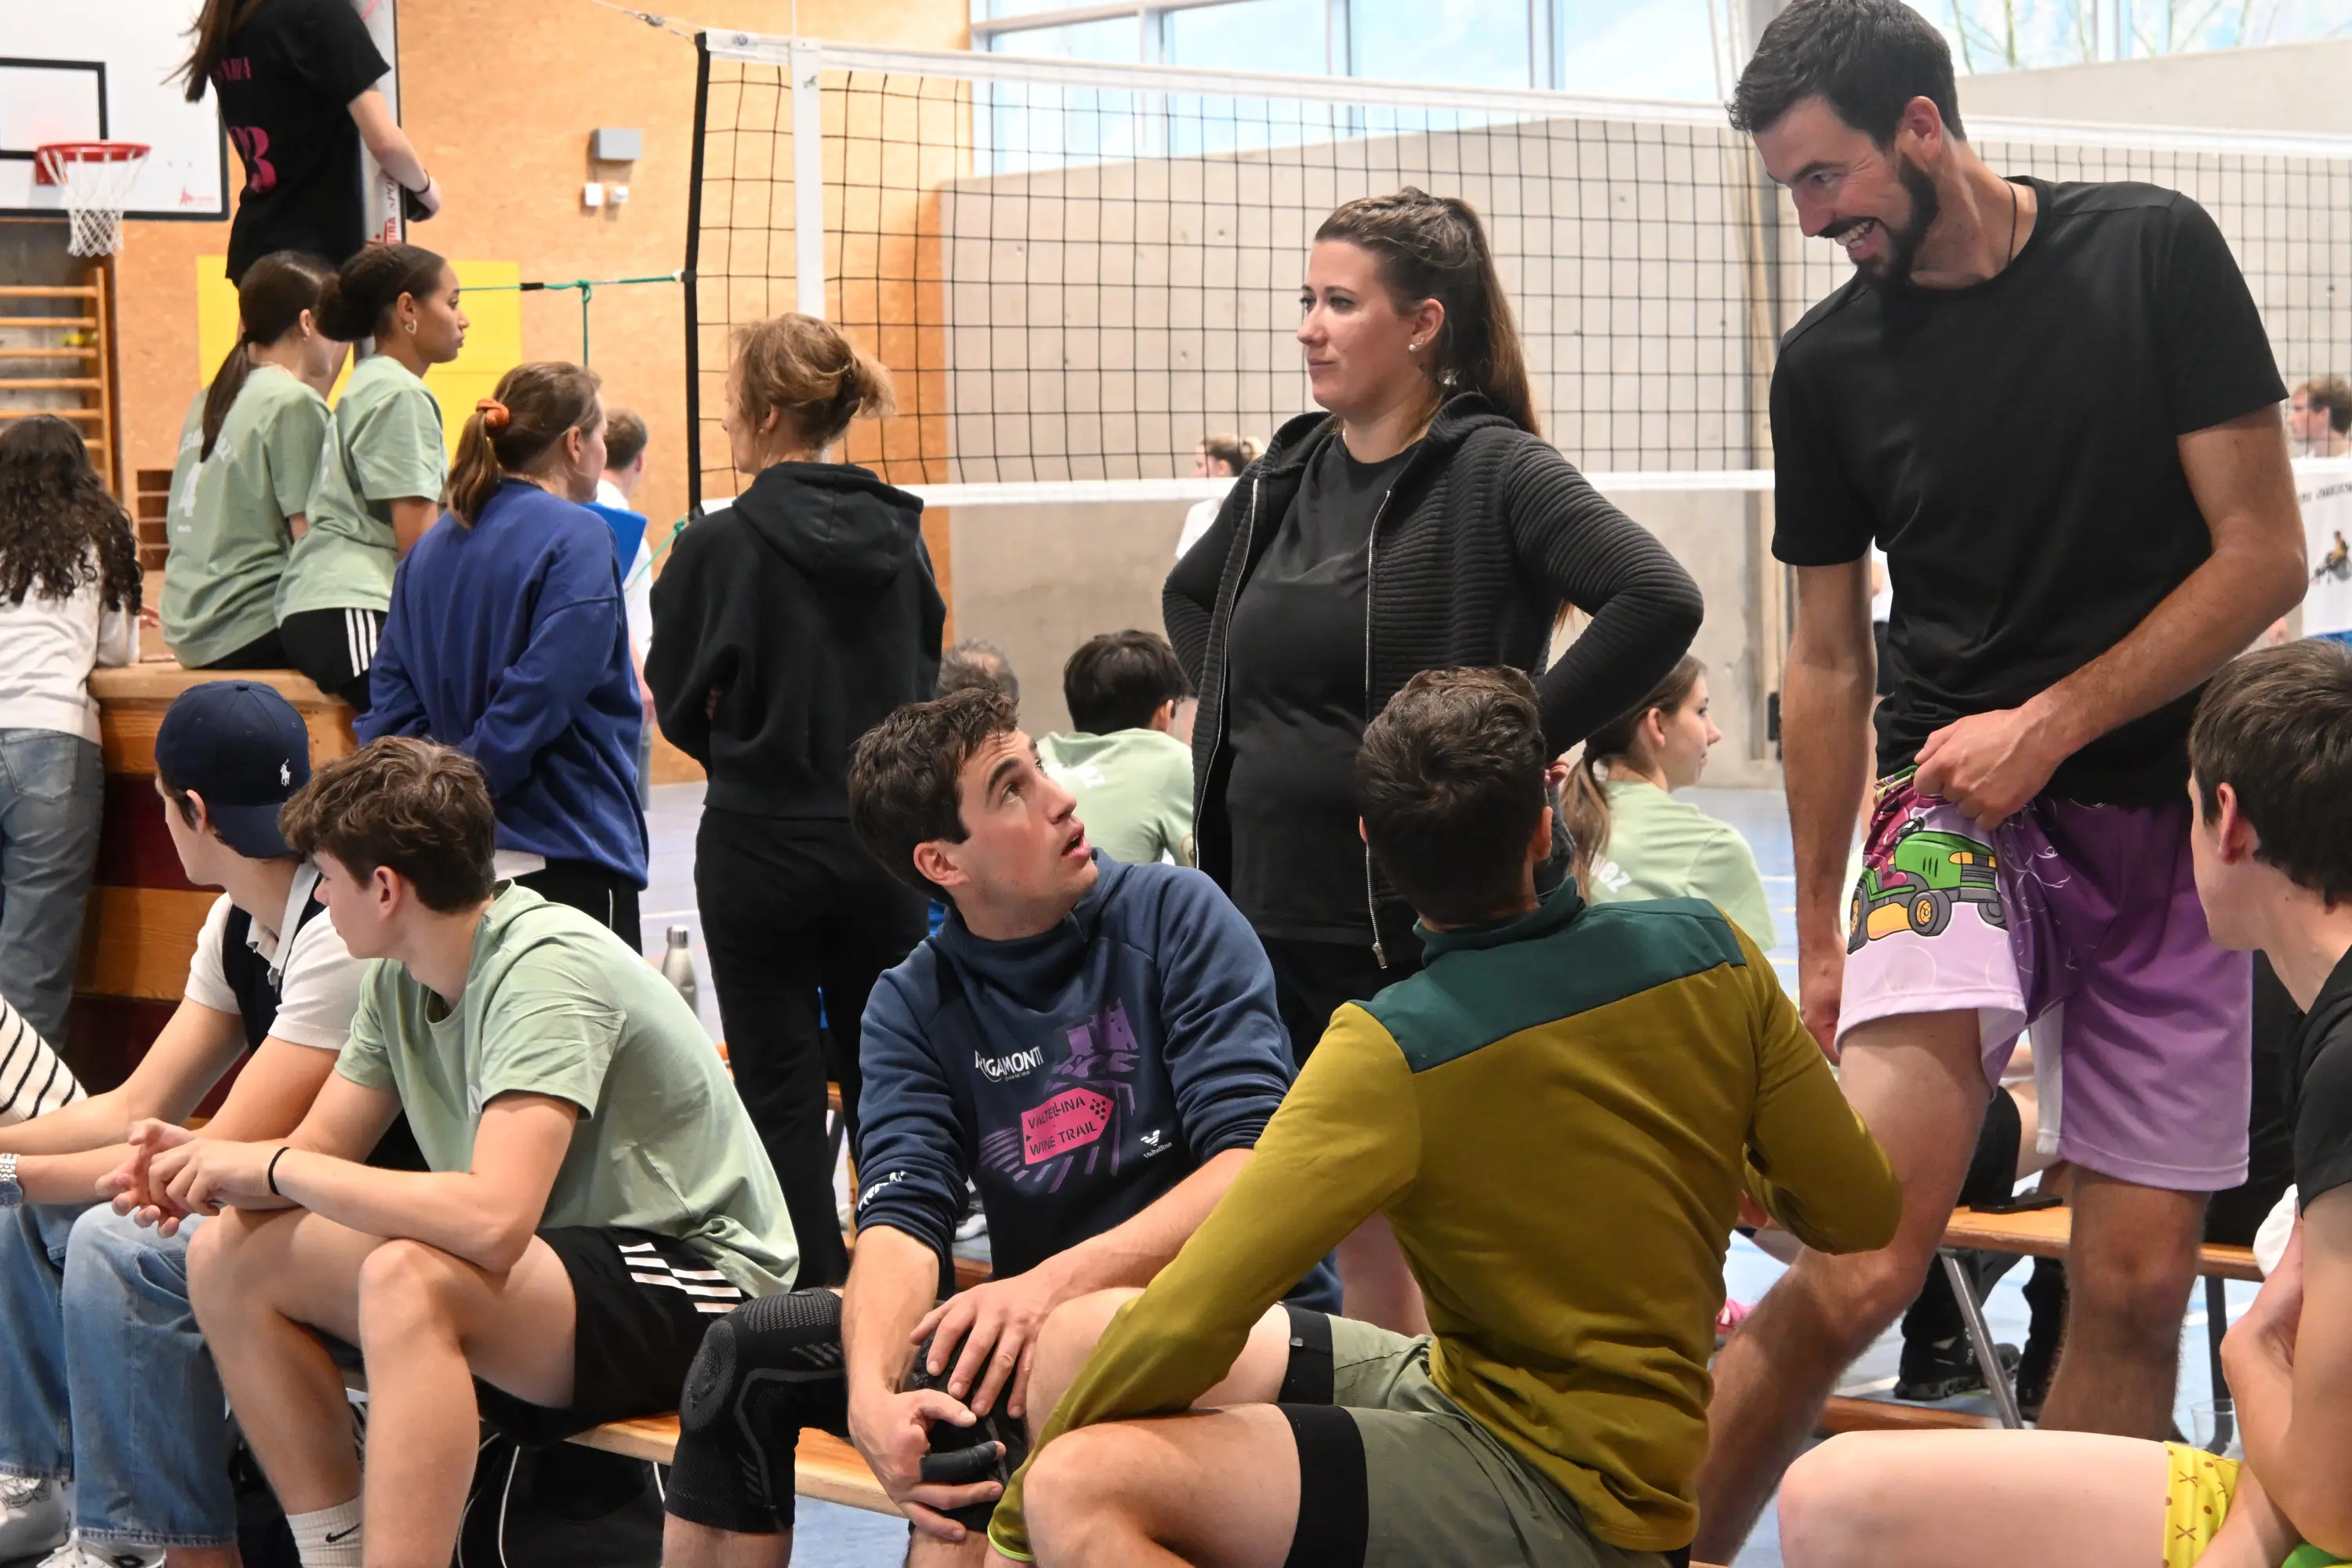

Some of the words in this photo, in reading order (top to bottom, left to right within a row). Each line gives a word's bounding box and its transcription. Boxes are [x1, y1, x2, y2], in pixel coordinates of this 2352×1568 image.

[975, 1046, 1044, 1082] RIGAMONTI
[1027, 1096, 1085, 1129] VALTELLINA
[1029, 1136, 1055, 1156] WINE
[1058, 1121, 1097, 1143] TRAIL
[1143, 1142, 1172, 1158] Valtellina
